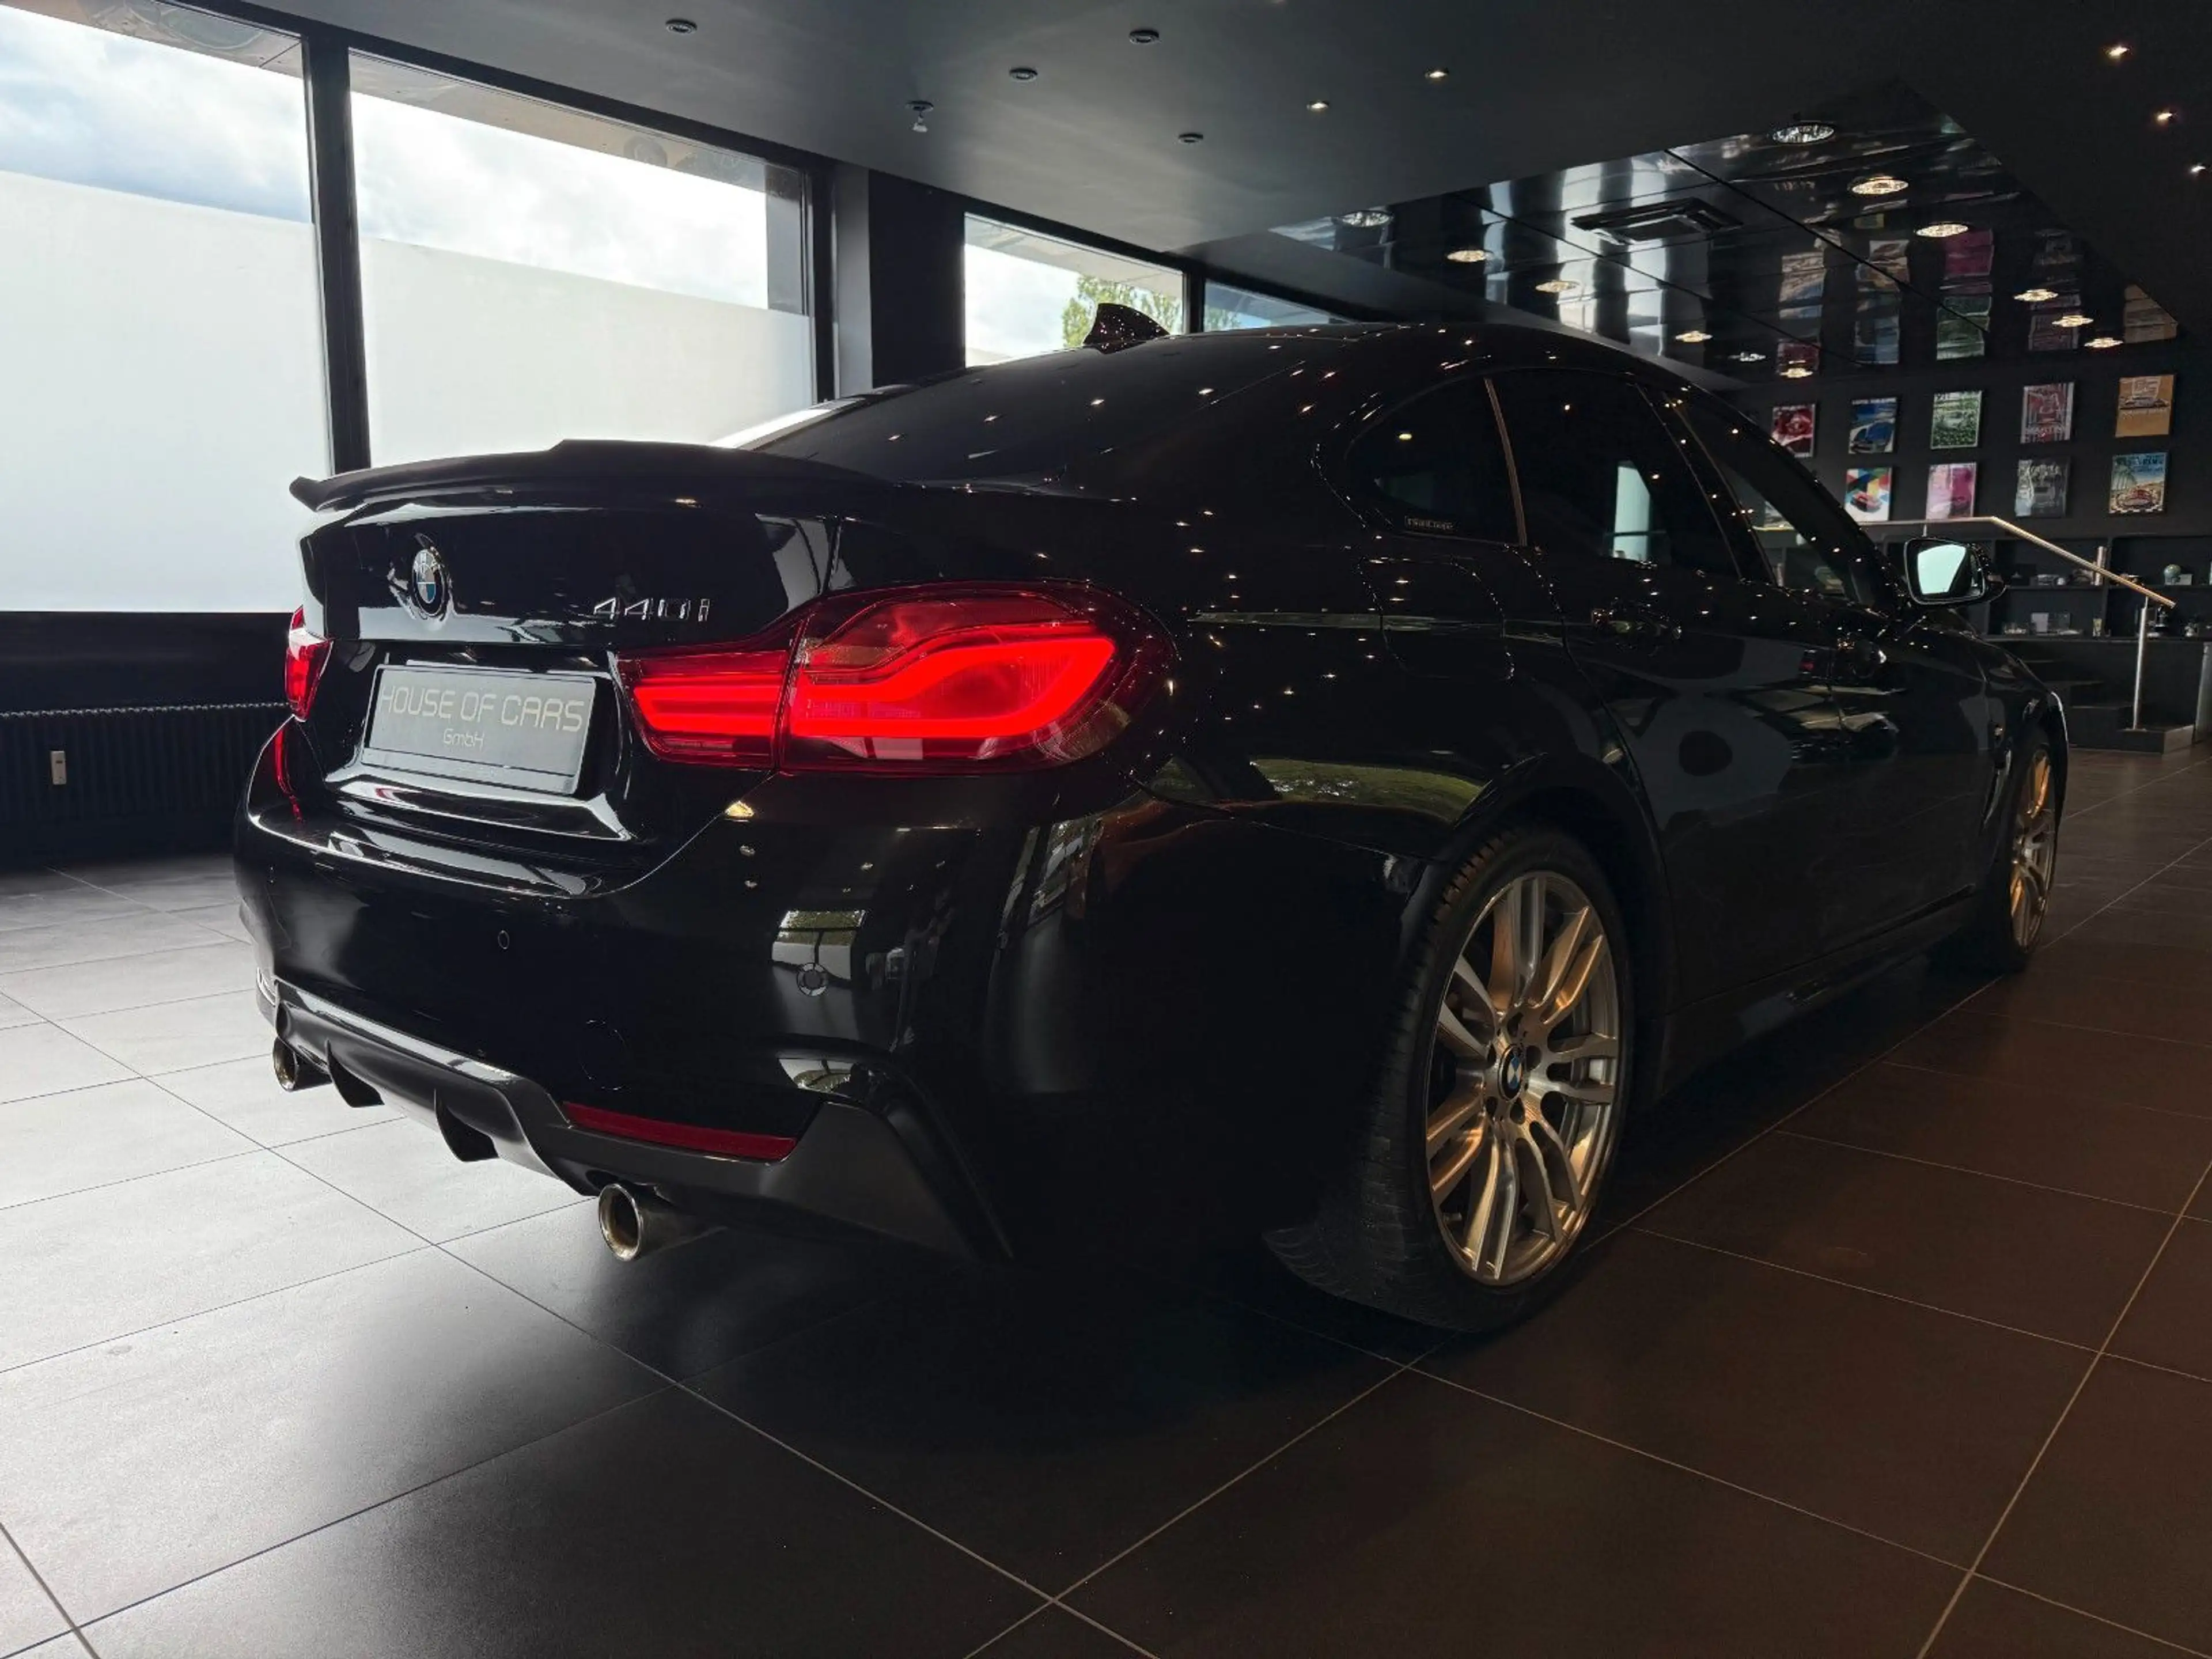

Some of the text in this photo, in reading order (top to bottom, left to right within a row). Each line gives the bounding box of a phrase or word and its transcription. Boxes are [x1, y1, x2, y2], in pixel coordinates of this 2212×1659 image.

[593, 597, 710, 622] 440i
[378, 686, 585, 732] HOUSE OF CARS
[443, 728, 485, 748] GmbH
